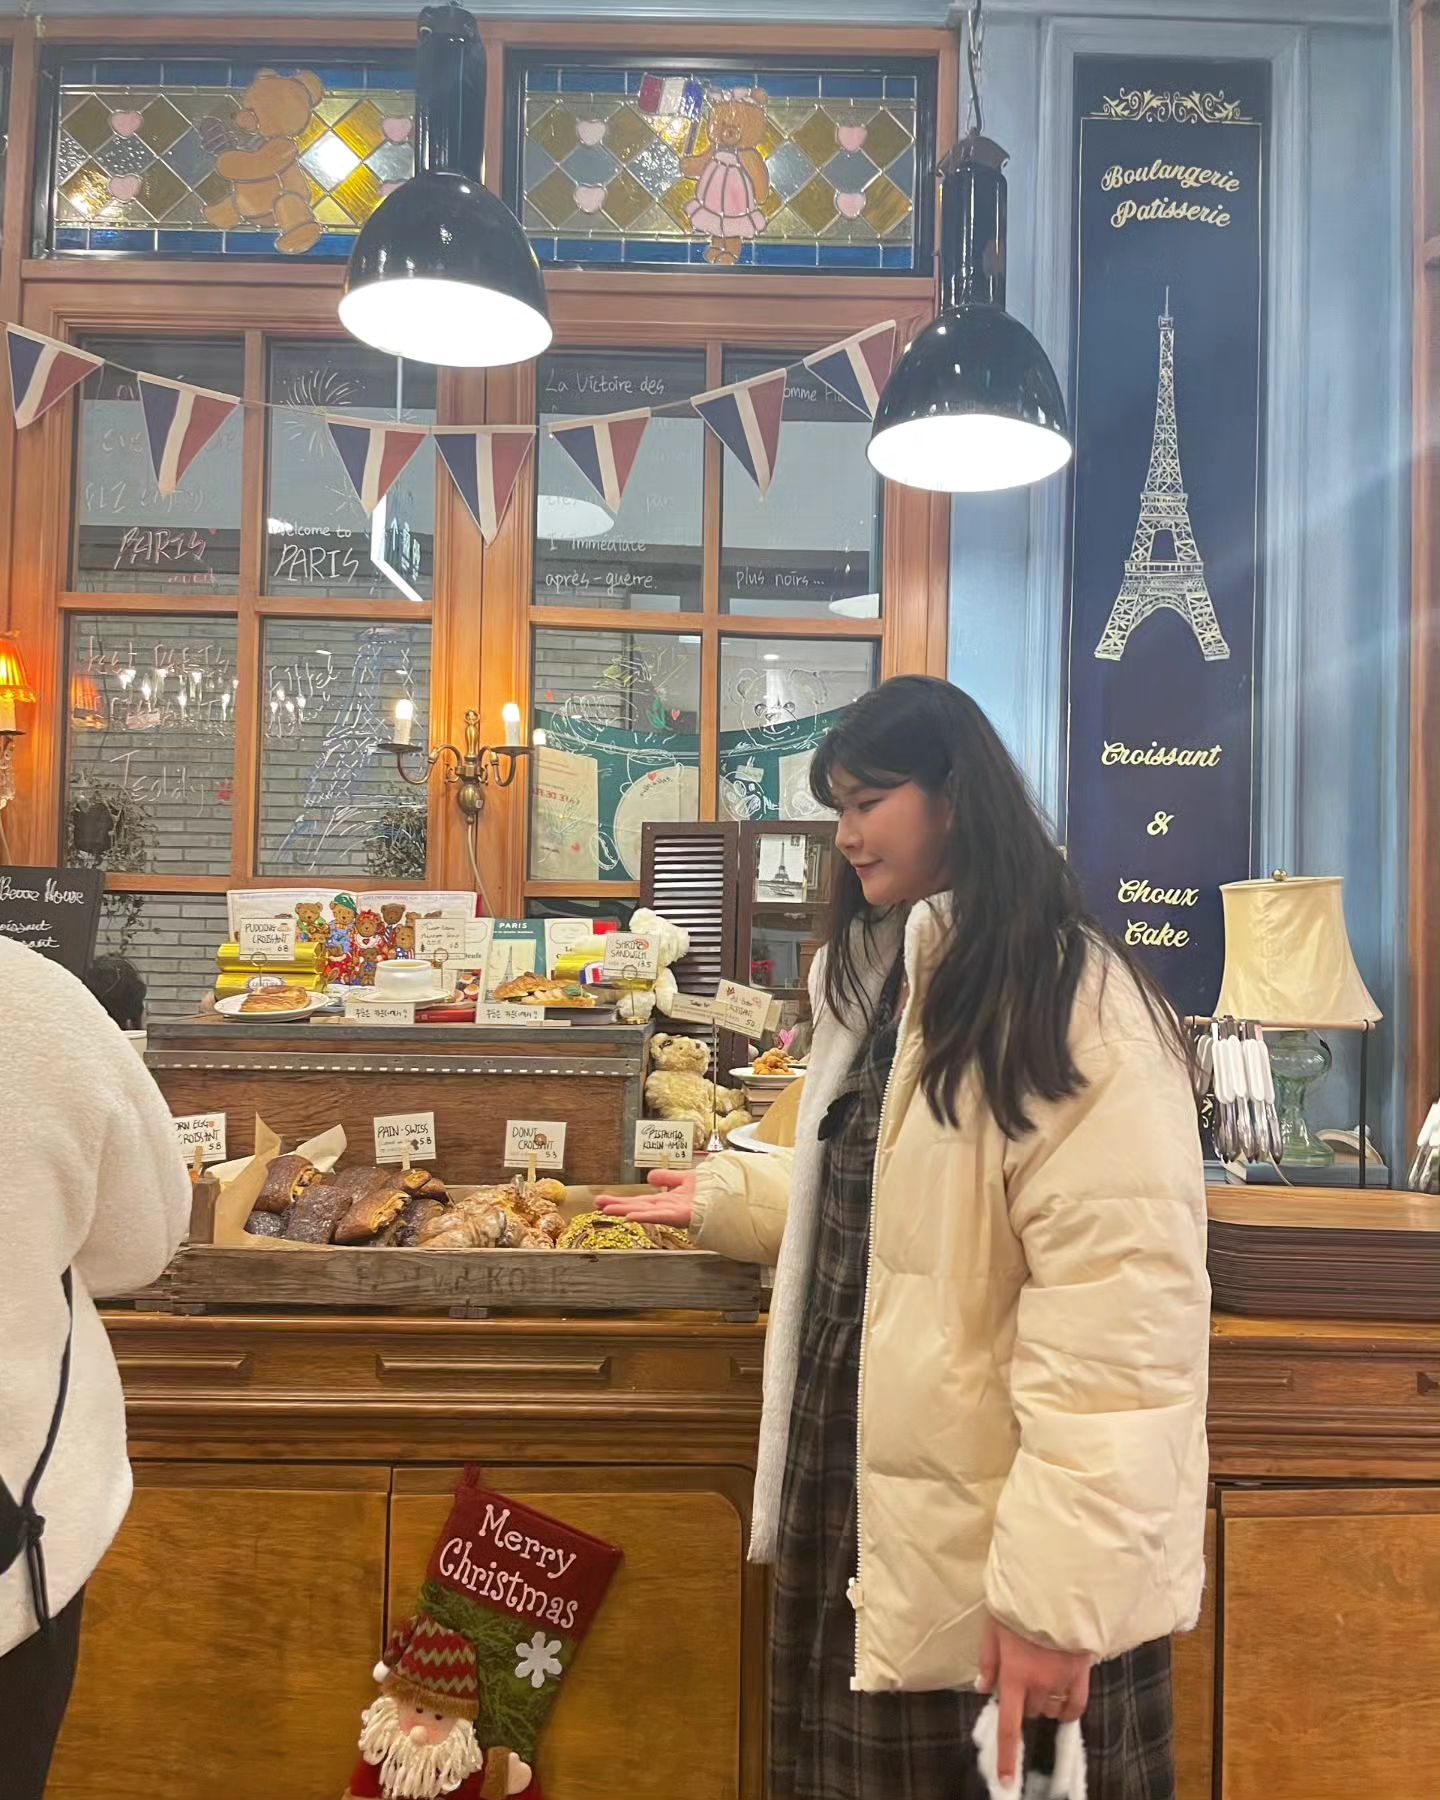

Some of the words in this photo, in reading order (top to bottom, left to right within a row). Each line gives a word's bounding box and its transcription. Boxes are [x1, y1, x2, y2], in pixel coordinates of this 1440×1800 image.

[1101, 159, 1240, 192] Boulangerie
[1111, 197, 1231, 228] Patisserie
[545, 368, 568, 393] La
[576, 371, 633, 393] Victoire
[639, 375, 665, 394] des
[336, 525, 352, 538] to
[274, 543, 359, 583] PARIS
[736, 567, 765, 589] plus
[1101, 740, 1222, 768] Croissant
[1147, 810, 1175, 836] &
[1117, 877, 1199, 907] Choux
[498, 922, 528, 930] PARIS
[1124, 918, 1190, 948] Cake
[193, 1120, 209, 1130] EGG
[512, 1126, 538, 1138] DONUT
[477, 1503, 577, 1579] Merry
[438, 1537, 579, 1629] Christmas
